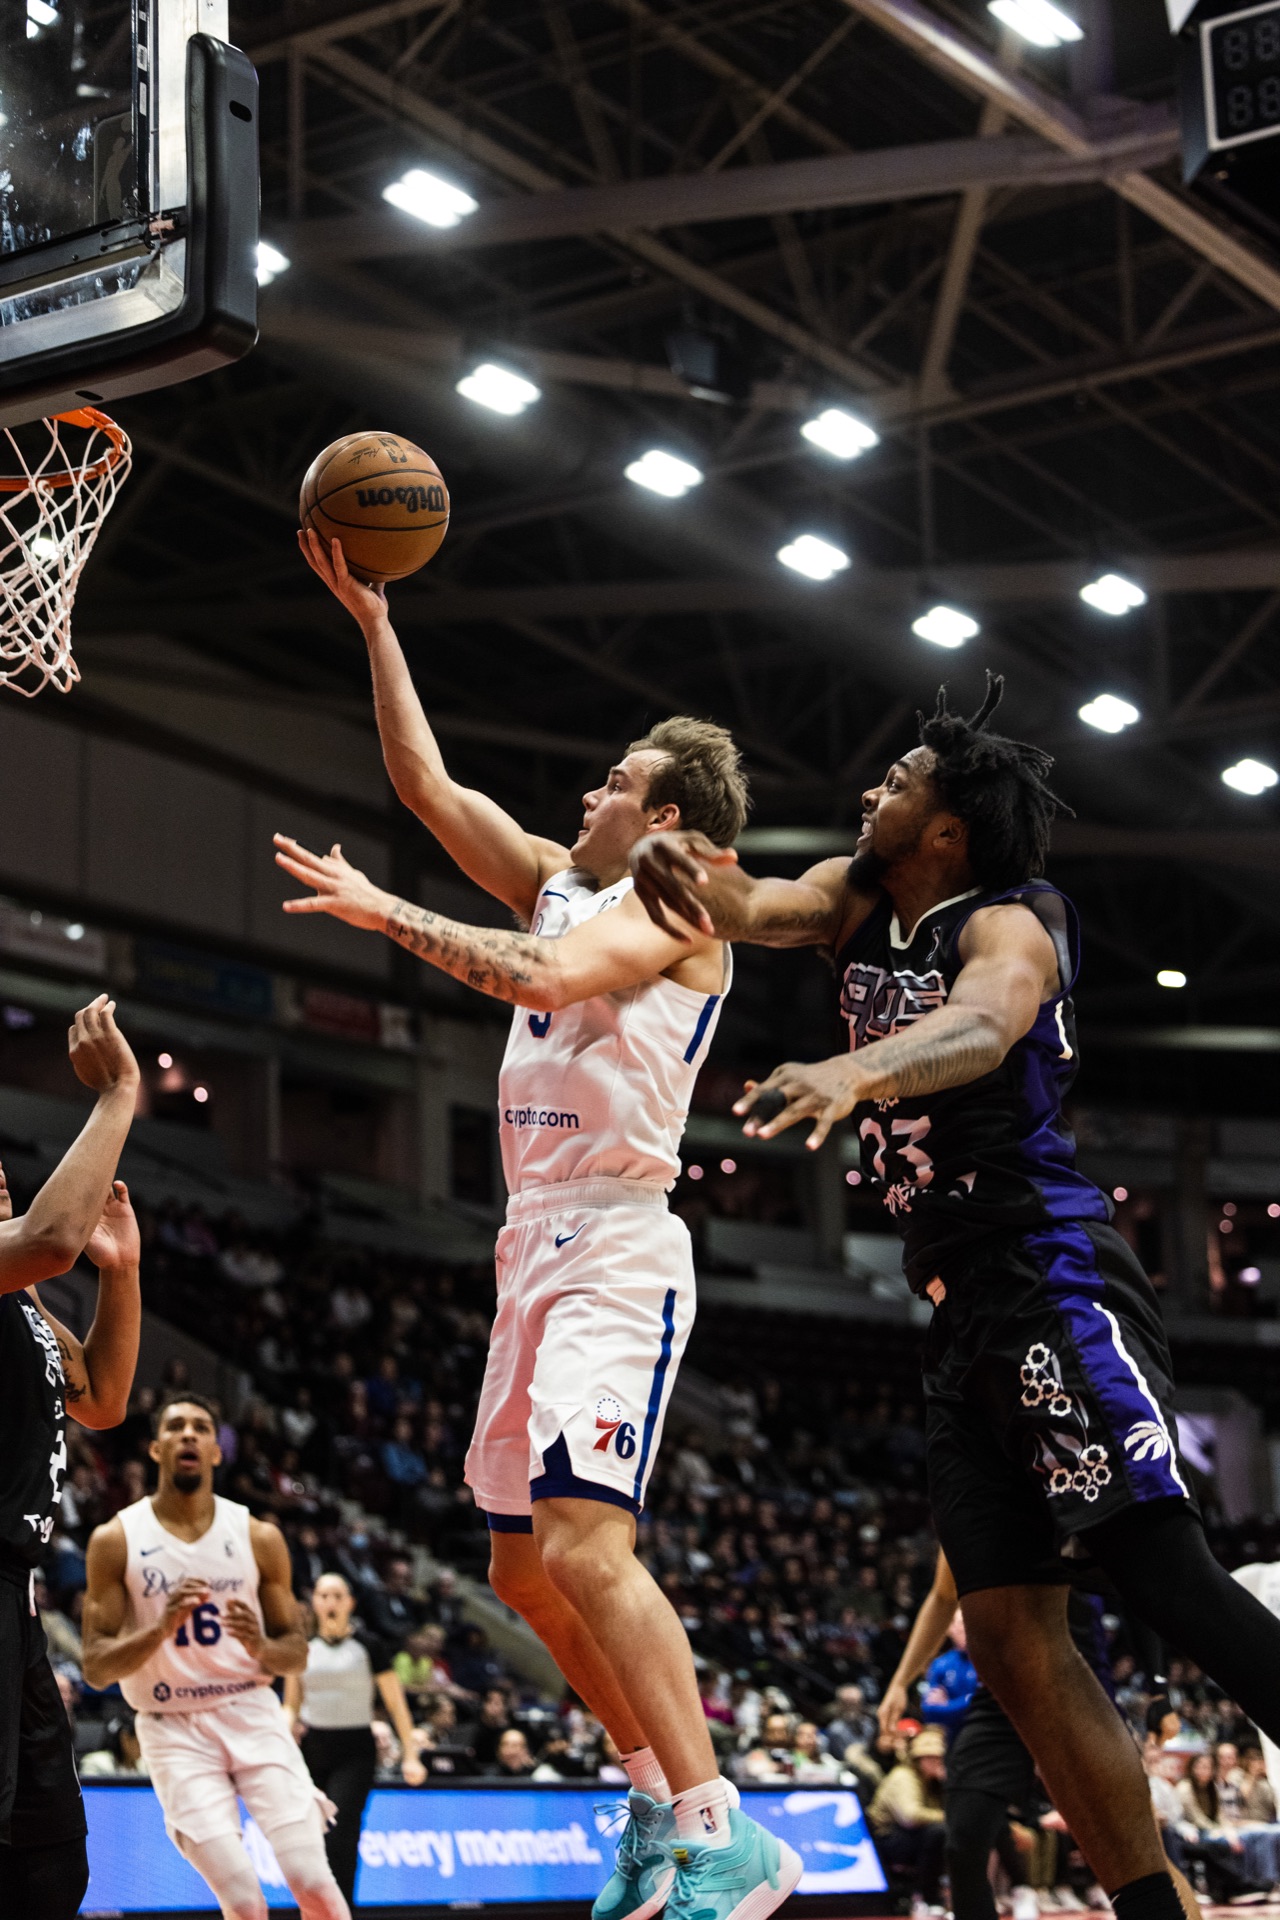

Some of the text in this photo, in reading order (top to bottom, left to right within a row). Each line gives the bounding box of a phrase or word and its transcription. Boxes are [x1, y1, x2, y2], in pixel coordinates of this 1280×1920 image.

[355, 484, 446, 513] Wilson
[859, 1115, 935, 1189] 23
[593, 1415, 636, 1459] 76
[175, 1680, 257, 1698] crypto.com
[358, 1821, 603, 1878] every moment.
